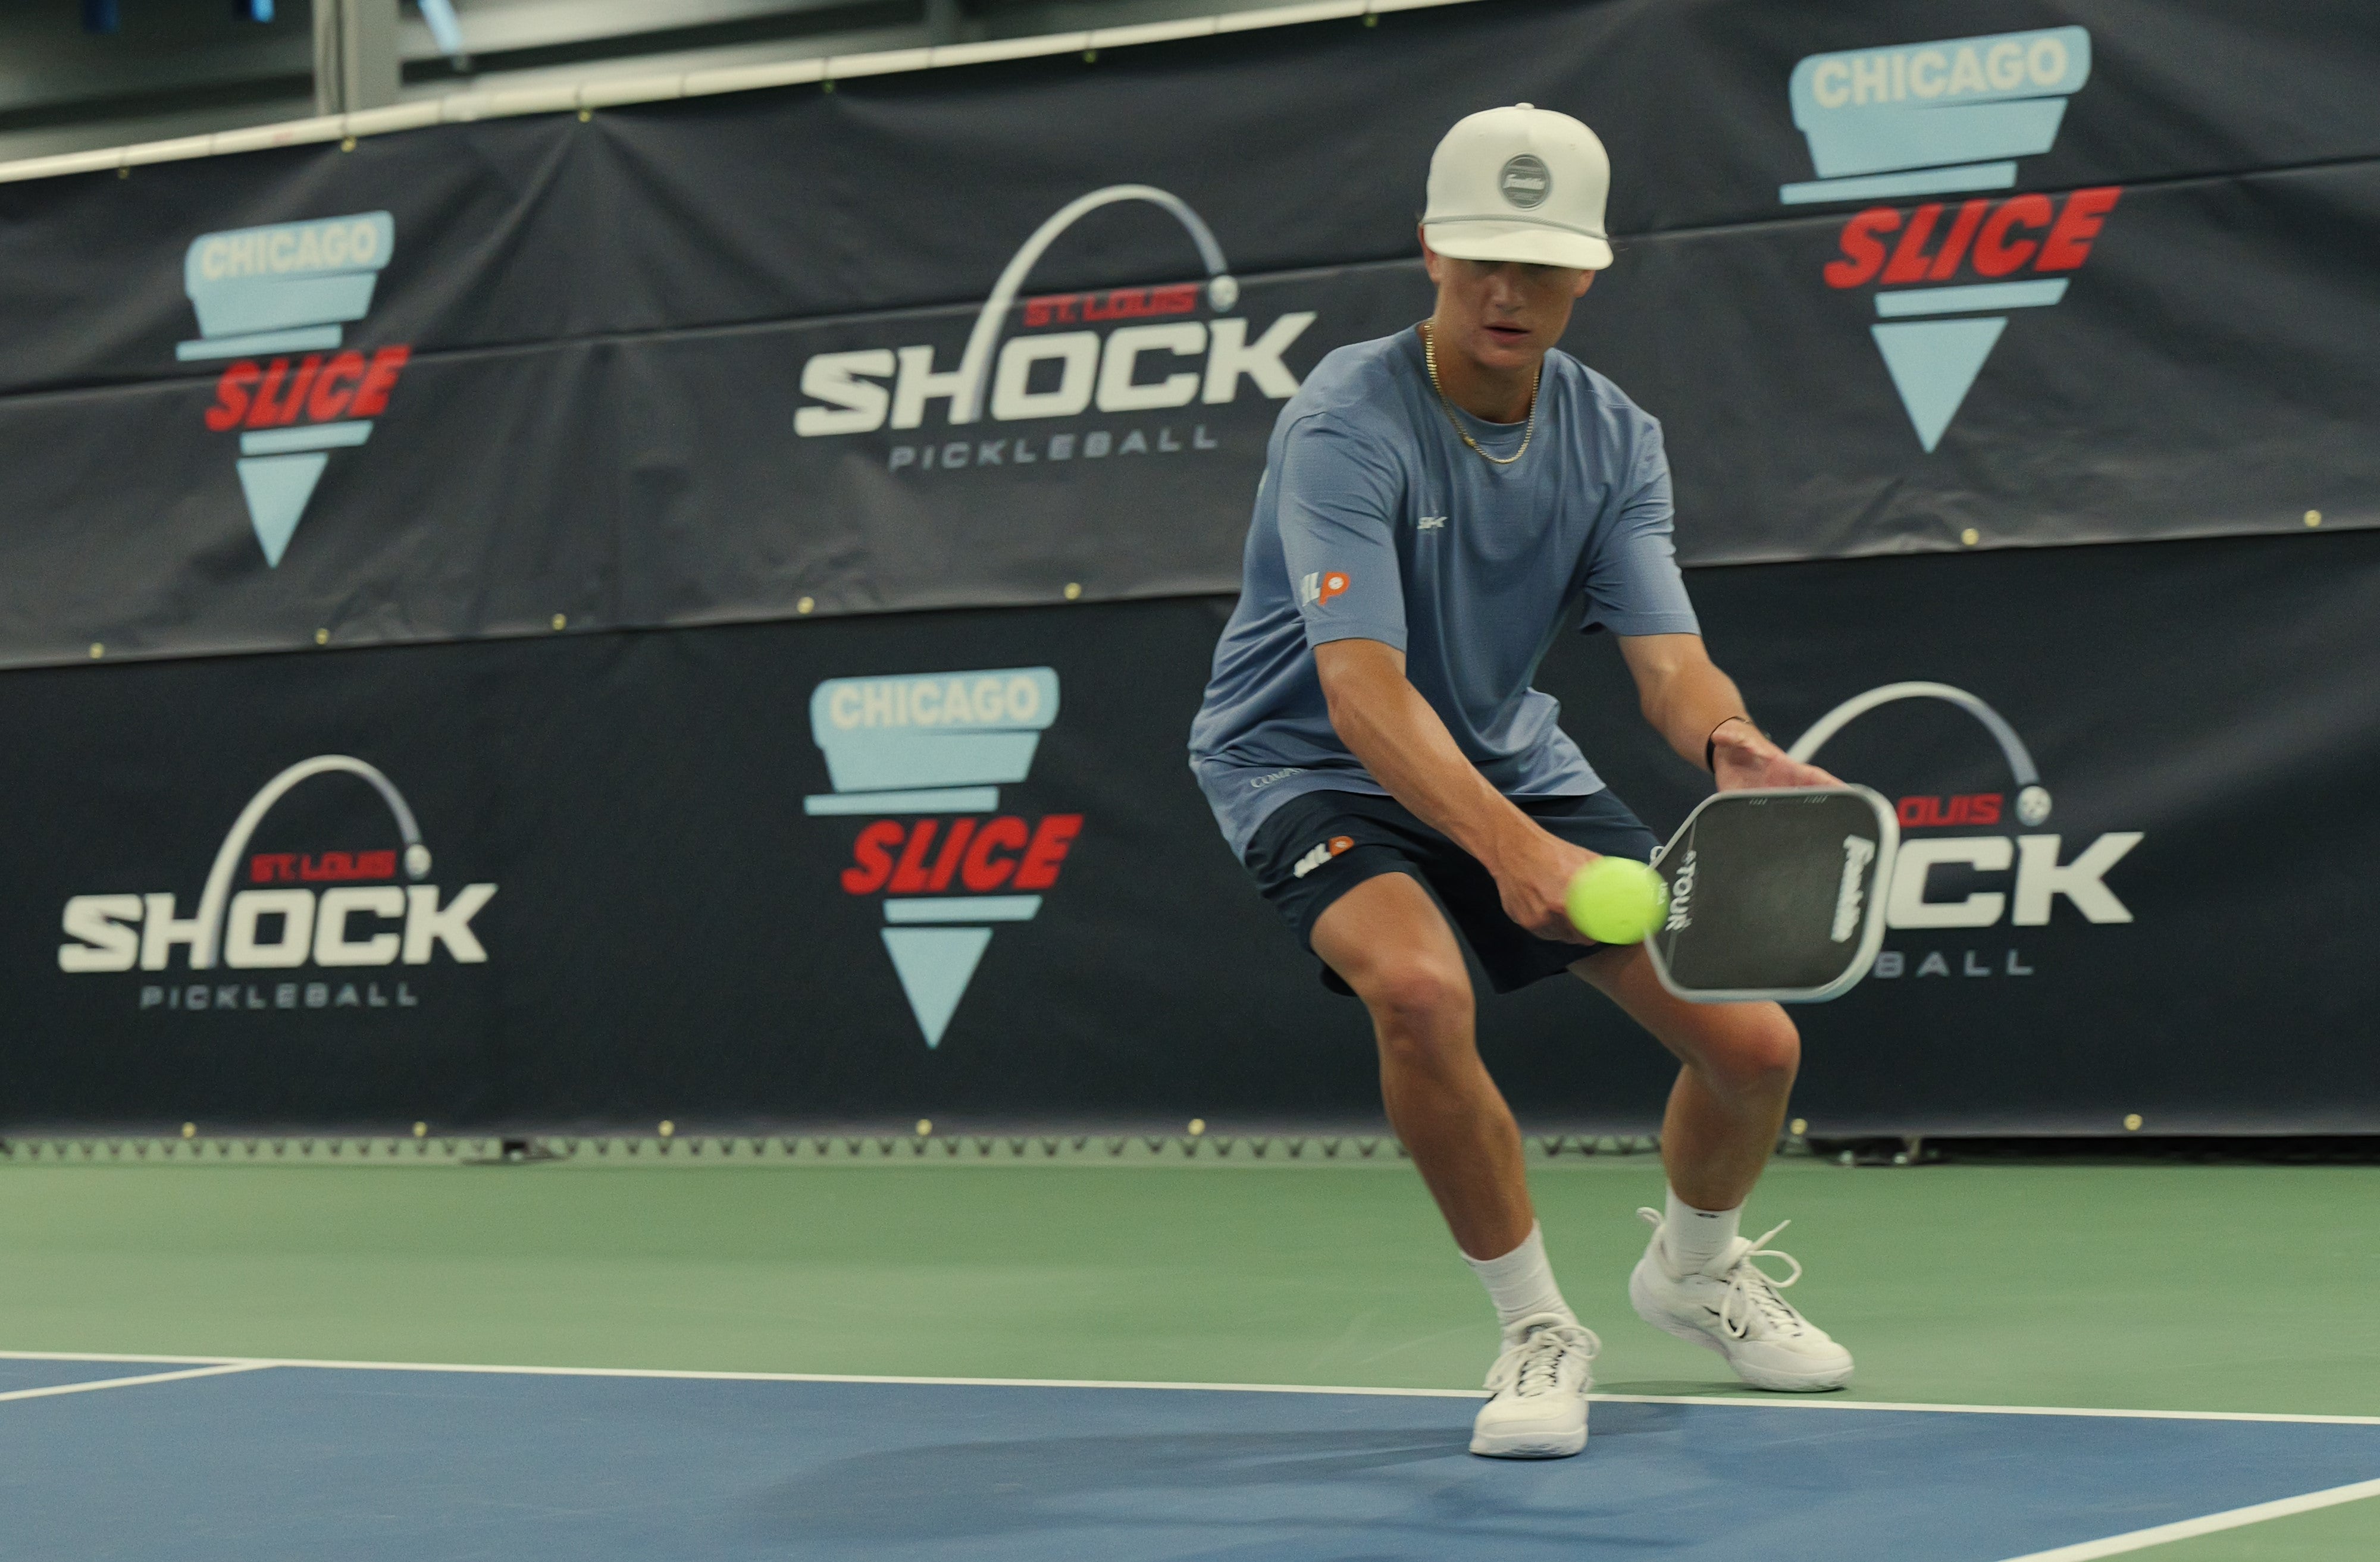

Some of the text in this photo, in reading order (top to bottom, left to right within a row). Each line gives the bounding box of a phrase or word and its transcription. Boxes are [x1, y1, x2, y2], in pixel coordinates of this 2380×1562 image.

[1812, 37, 2068, 108] CHICAGO
[201, 220, 377, 280] CHICAGO
[1823, 186, 2123, 289] SLICE
[1083, 283, 1198, 322] LOUIS
[205, 344, 411, 432] SLICE
[794, 311, 1317, 437] SHOCK
[888, 425, 1218, 472] PICKLEBALL
[831, 675, 1041, 730] CHICAGO
[1896, 793, 2003, 828] OUIS
[299, 850, 397, 881] LOUIS
[840, 814, 1084, 895] SLICE
[58, 883, 499, 973] SHOCK
[140, 983, 418, 1010] PICKLEBALL
